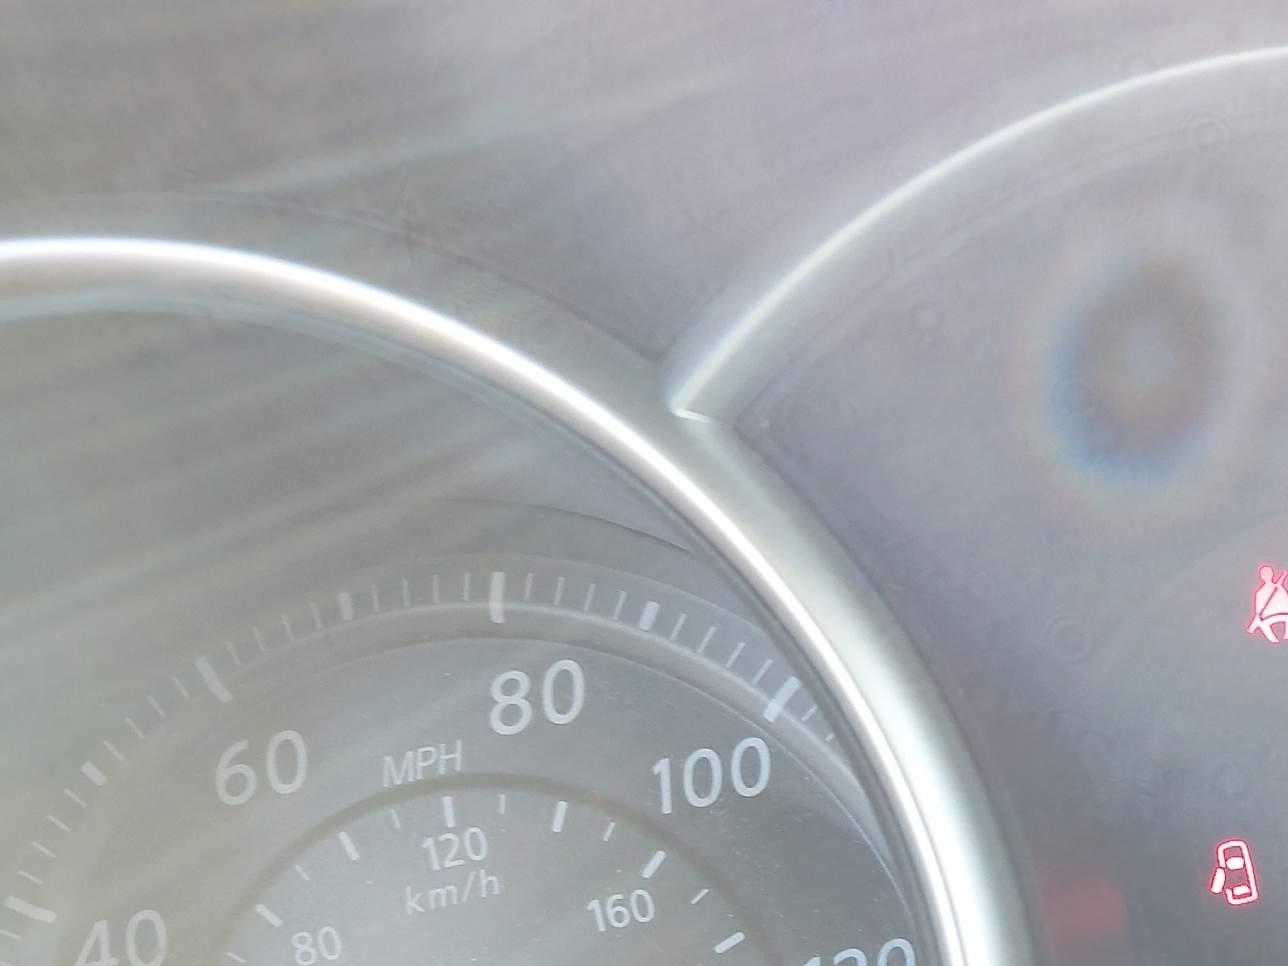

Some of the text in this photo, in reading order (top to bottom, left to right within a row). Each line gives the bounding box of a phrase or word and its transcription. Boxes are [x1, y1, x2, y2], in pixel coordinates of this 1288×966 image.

[489, 659, 586, 736] 80
[214, 729, 309, 806] 60
[382, 739, 464, 788] MPH
[652, 736, 772, 815] 100
[421, 826, 489, 871] 120
[405, 867, 502, 916] km/h
[586, 888, 656, 932] 160
[290, 925, 343, 966] 80
